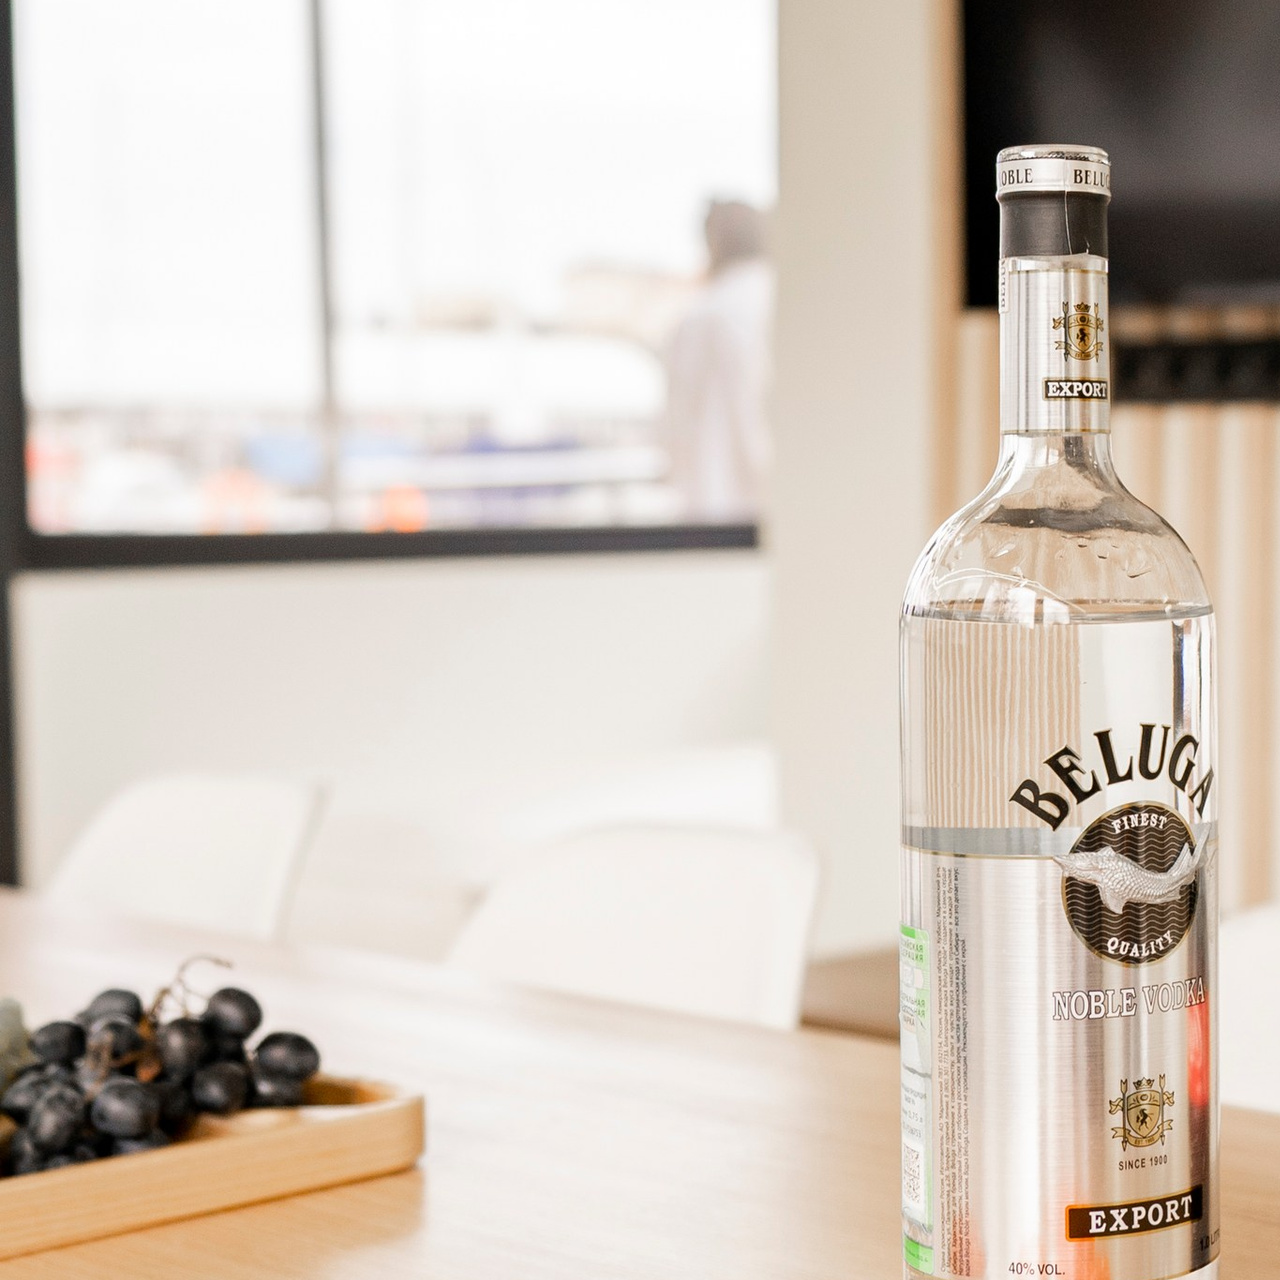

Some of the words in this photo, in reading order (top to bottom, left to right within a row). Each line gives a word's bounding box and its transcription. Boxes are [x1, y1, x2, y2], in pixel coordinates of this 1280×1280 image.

[1001, 168, 1033, 186] OBLE
[1074, 169, 1110, 189] BELU
[1047, 381, 1107, 398] EXPORT
[1009, 723, 1214, 832] BELUGA
[1111, 812, 1168, 834] FINEST
[1106, 929, 1173, 958] QUALITY
[1052, 987, 1137, 1021] NOBLE
[1142, 976, 1206, 1014] VODKA
[1118, 1158, 1146, 1172] SINCE
[1150, 1154, 1168, 1167] 1900
[1088, 1194, 1192, 1234] EXPORT
[1008, 1262, 1035, 1276] 40%
[1037, 1263, 1066, 1276] VOL.
